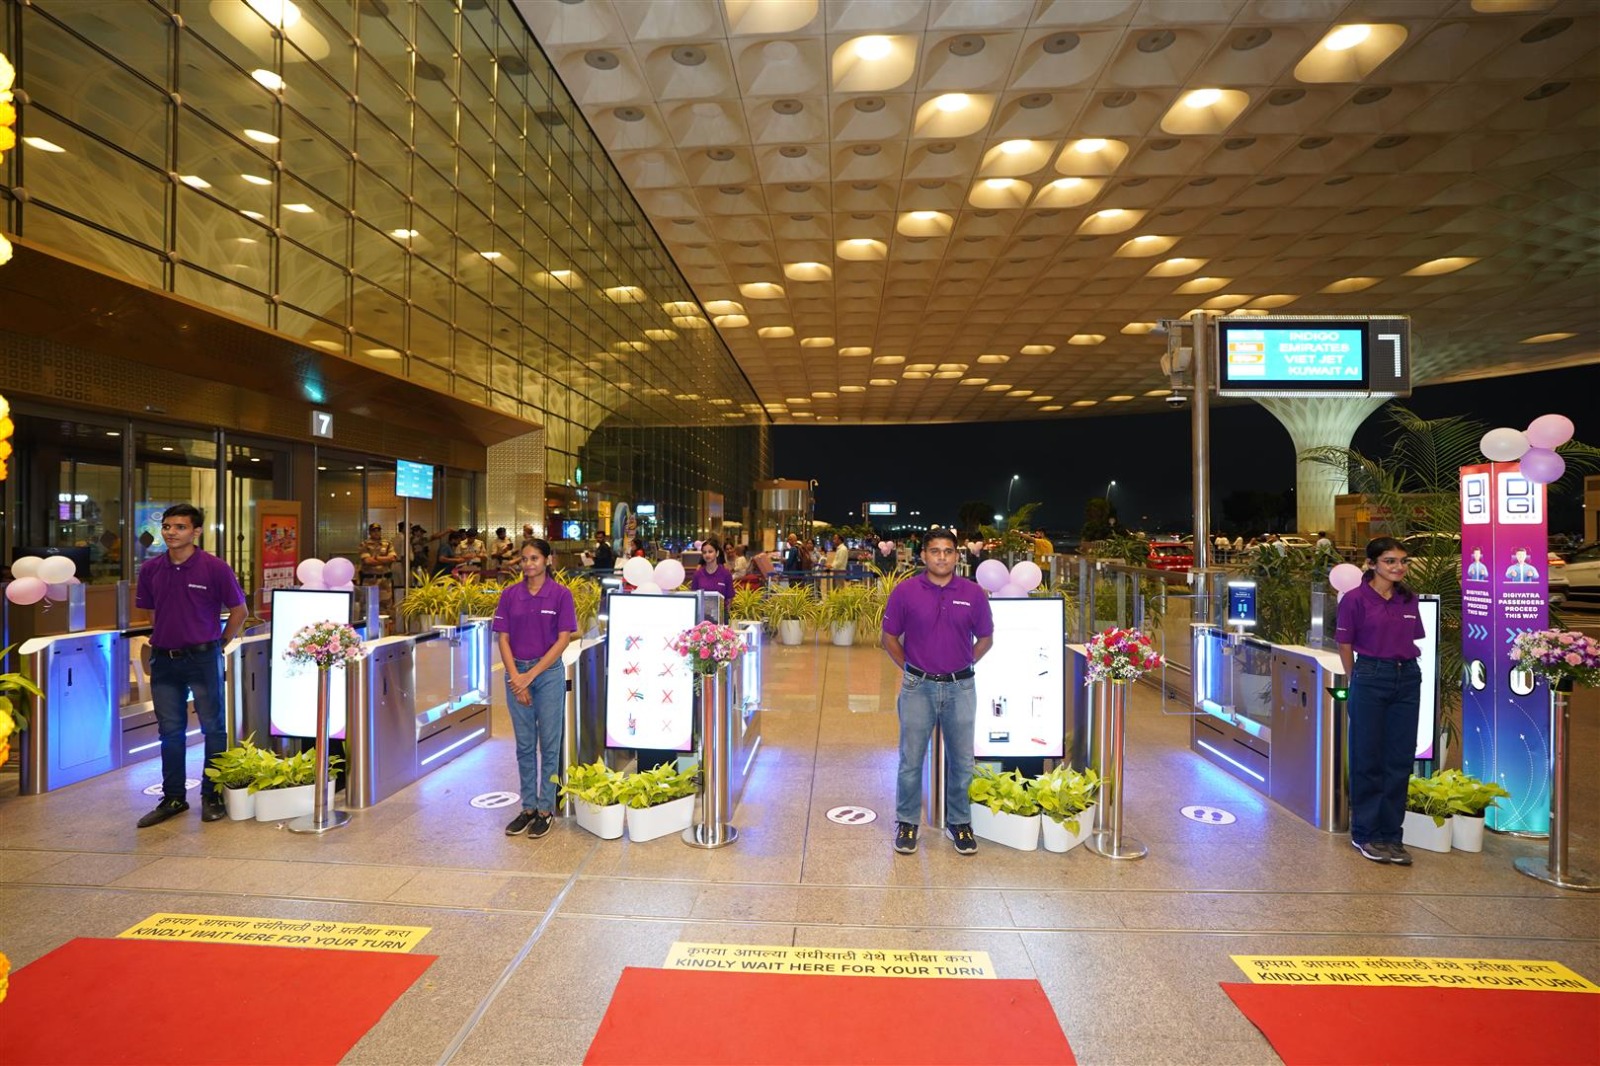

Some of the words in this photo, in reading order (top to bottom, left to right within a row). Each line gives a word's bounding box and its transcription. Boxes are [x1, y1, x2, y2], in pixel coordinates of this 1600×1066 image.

[1289, 332, 1340, 341] INDIGO
[1279, 343, 1349, 353] EMIRATES
[1378, 334, 1401, 377] 7
[1284, 355, 1315, 364] VIET
[1318, 355, 1345, 364] JET
[1288, 366, 1341, 376] KUWAIT
[319, 414, 330, 435] 7
[156, 916, 198, 927] कृपया
[199, 918, 251, 928] आपल्या
[313, 923, 336, 933] येथे
[340, 926, 383, 936] प्रतीक्षा
[385, 929, 413, 938] करा
[132, 927, 190, 937] KINDLY
[190, 930, 234, 940] WAIT
[232, 933, 278, 942] HERE
[276, 935, 311, 944] FOR
[315, 937, 358, 947] YOUR
[361, 939, 407, 949] TURN
[687, 947, 728, 957] कृपया
[734, 948, 788, 958] आपल्या
[795, 949, 856, 960] संधीसाठी
[862, 952, 886, 961] येथे
[893, 952, 938, 962] प्रतीक्षा
[945, 954, 973, 963] करा
[675, 958, 736, 969] KINDLY
[741, 961, 785, 970] WAIT
[790, 963, 835, 972] HERE
[841, 965, 875, 973] FOR
[881, 965, 930, 975] YOUR
[934, 966, 984, 975] TURN
[1252, 959, 1297, 970] कृपया
[1301, 960, 1360, 969] आपल्या
[1517, 964, 1556, 974] करा
[1257, 972, 1321, 981] KINDLY
[1324, 973, 1372, 982] WAIT
[1375, 973, 1428, 983] HERE
[1428, 974, 1471, 984] FOR
[1468, 975, 1528, 987] YOUR
[1525, 977, 1588, 989] TURN
